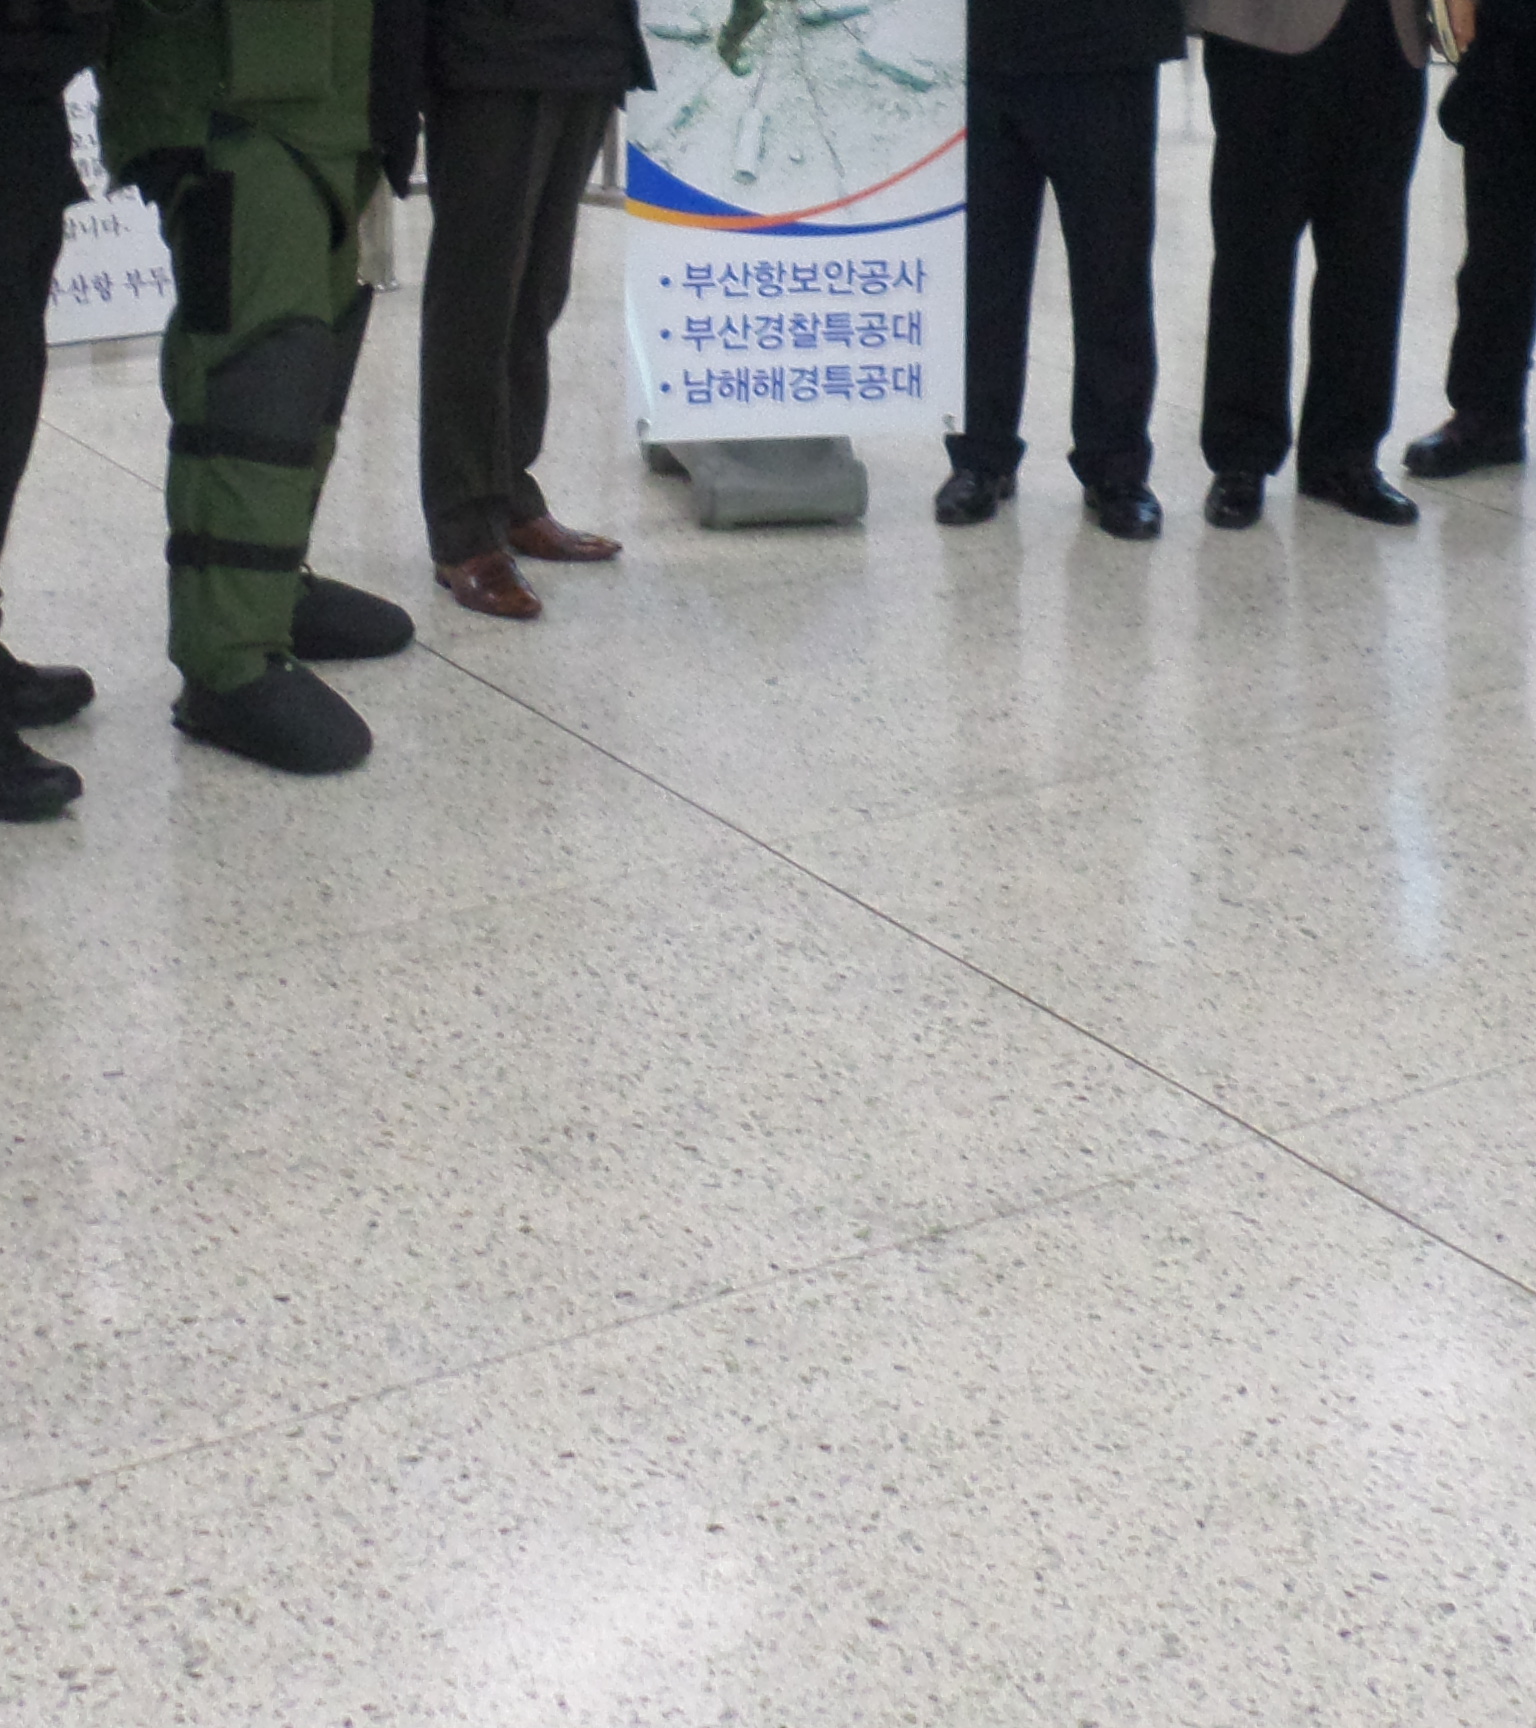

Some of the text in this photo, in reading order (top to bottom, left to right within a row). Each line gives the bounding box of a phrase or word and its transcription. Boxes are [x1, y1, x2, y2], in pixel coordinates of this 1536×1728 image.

[681, 258, 927, 299] 부산항보안공사
[681, 310, 923, 352] 부산경찰특공대
[681, 362, 923, 405] 남해해경특공대
